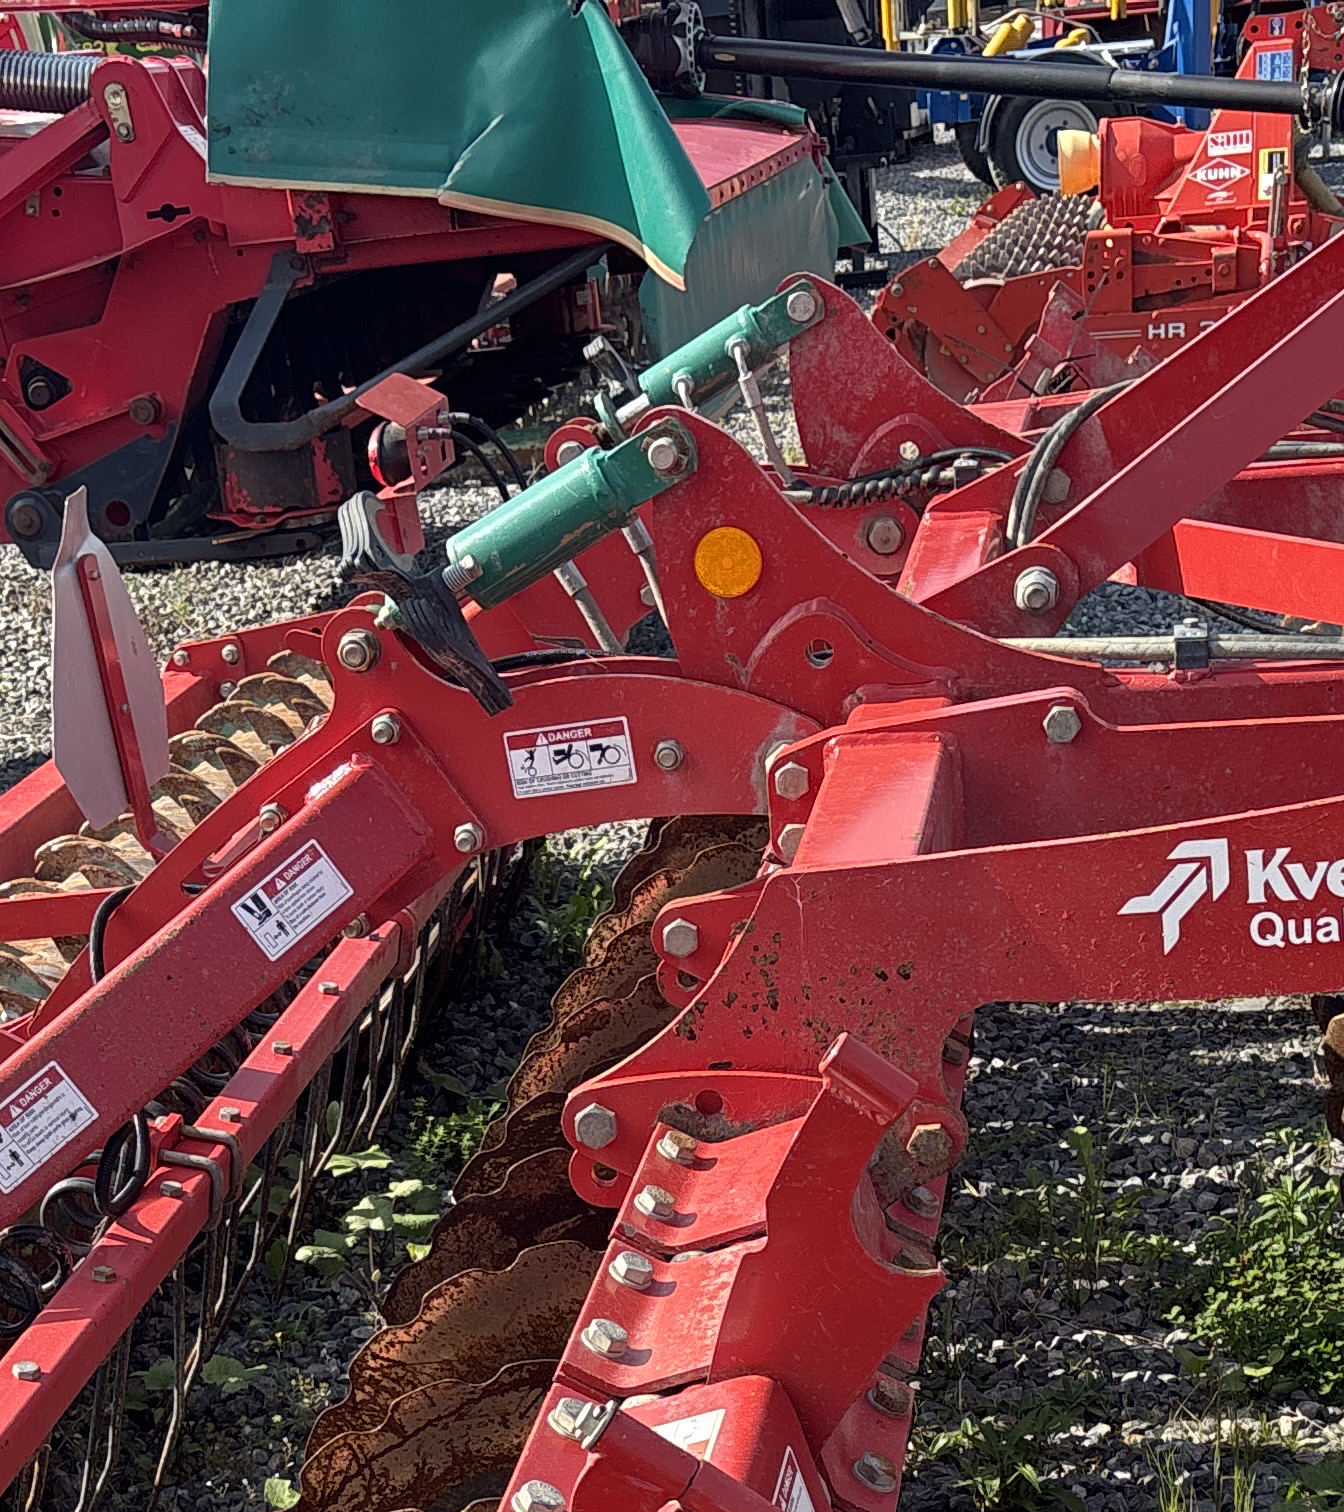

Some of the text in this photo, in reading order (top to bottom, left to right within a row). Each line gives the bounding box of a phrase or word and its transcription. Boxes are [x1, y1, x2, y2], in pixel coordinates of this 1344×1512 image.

[1196, 167, 1242, 181] KUHN
[1147, 322, 1186, 340] HR
[548, 727, 593, 742] DANGER
[282, 853, 314, 881] DANGER
[18, 1077, 53, 1108] DANGER
